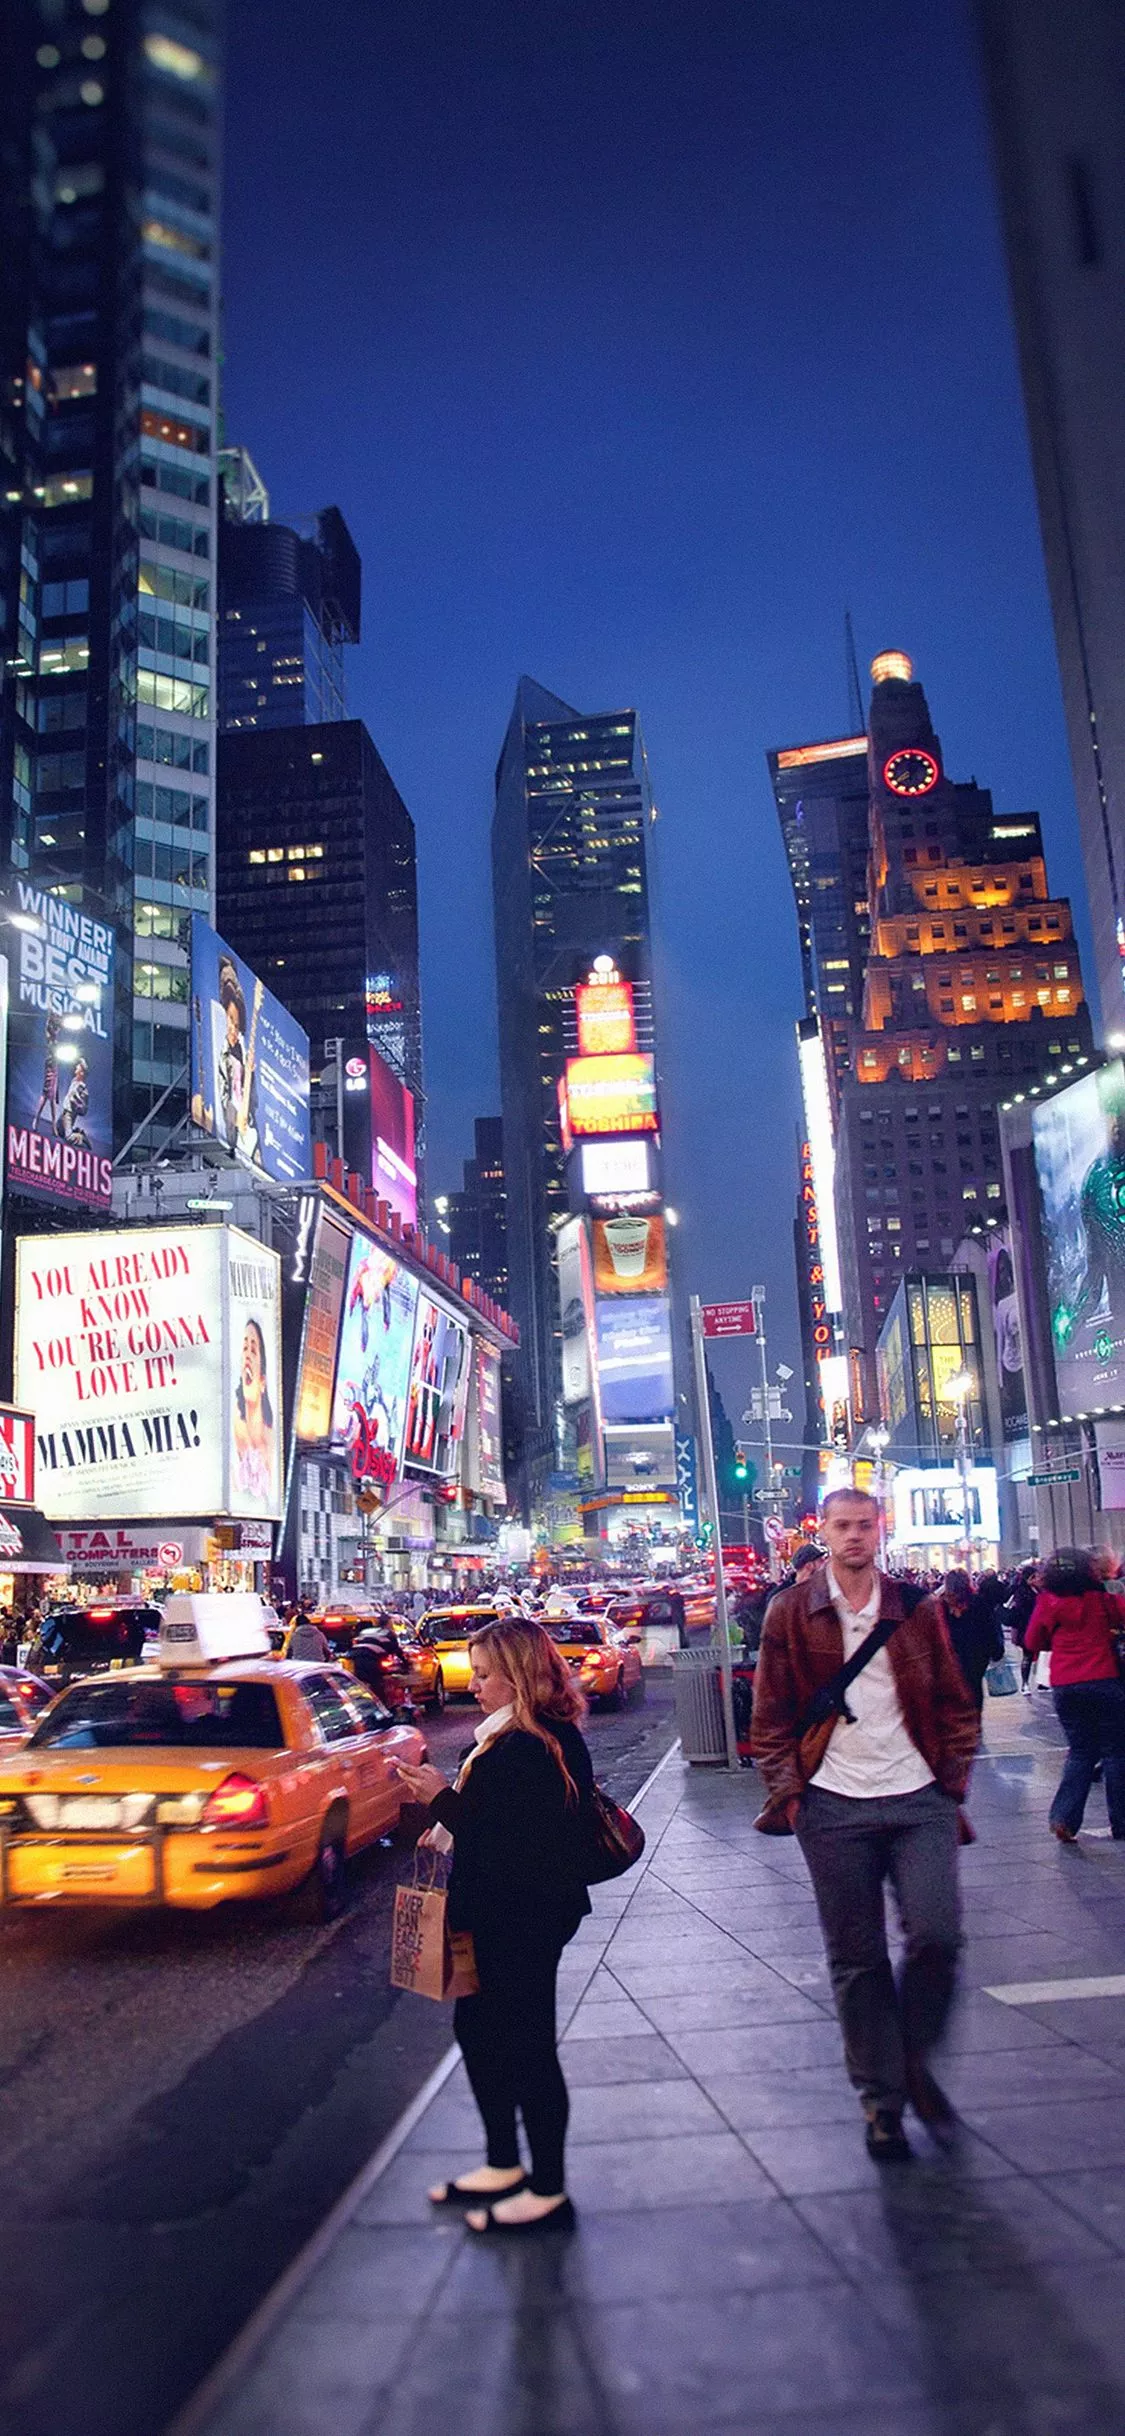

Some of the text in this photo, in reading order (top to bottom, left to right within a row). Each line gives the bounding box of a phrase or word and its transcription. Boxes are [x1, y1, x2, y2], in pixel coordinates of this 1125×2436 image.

[18, 882, 112, 954] WINNER!
[21, 933, 108, 1010] BEST
[20, 975, 108, 1038] MUSICAL
[573, 1114, 657, 1134] TOSHIBA
[8, 1127, 112, 1195] MEMPHIS
[803, 1142, 819, 1243] ERNST
[32, 1245, 191, 1299] YOU ALREADY
[810, 1266, 824, 1283] &
[80, 1287, 152, 1328] KNOW
[32, 1315, 210, 1370] YOU'RE GONNA
[75, 1353, 177, 1400] LOVE IT!
[37, 1422, 136, 1472] MAMMA
[142, 1410, 200, 1455] MIA!
[66, 1547, 159, 1560] COMPUTERS
